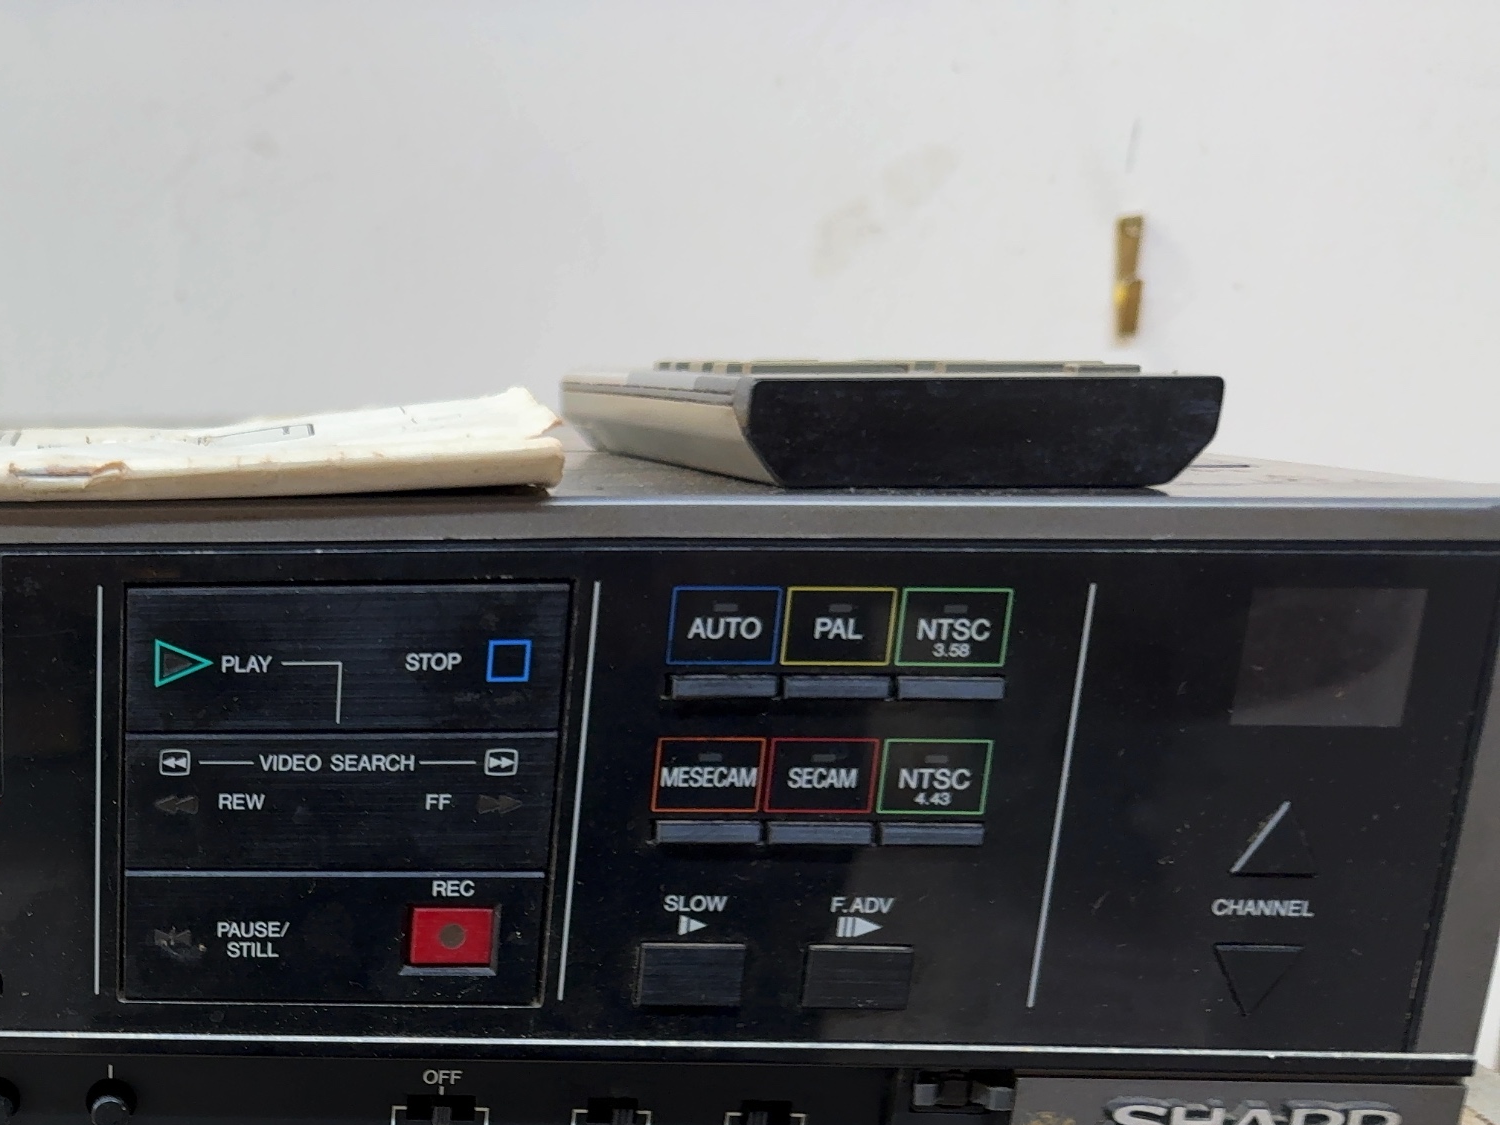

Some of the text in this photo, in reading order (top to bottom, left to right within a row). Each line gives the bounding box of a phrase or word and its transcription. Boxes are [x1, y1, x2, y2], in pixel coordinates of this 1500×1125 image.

[687, 616, 763, 640] AUTO
[813, 617, 863, 640] PAL
[916, 618, 991, 641] NTSC
[931, 643, 970, 658] 3.58
[221, 655, 272, 673] PLAY
[405, 653, 462, 671] STOP
[259, 754, 415, 772] VIDEO SEARCH
[660, 766, 759, 789] MESECAM
[787, 767, 858, 790] SECAM
[898, 767, 971, 790] NTSC
[218, 794, 265, 810] REW
[425, 794, 453, 811] FF
[914, 791, 951, 807] 4.43
[431, 880, 475, 897] REC
[663, 895, 728, 912] SLOW
[830, 896, 895, 914] F.ADV
[1211, 898, 1315, 918] CHANNEL
[217, 921, 290, 938] PAUSE/
[227, 942, 279, 959] STILL
[422, 1070, 462, 1085] OFF
